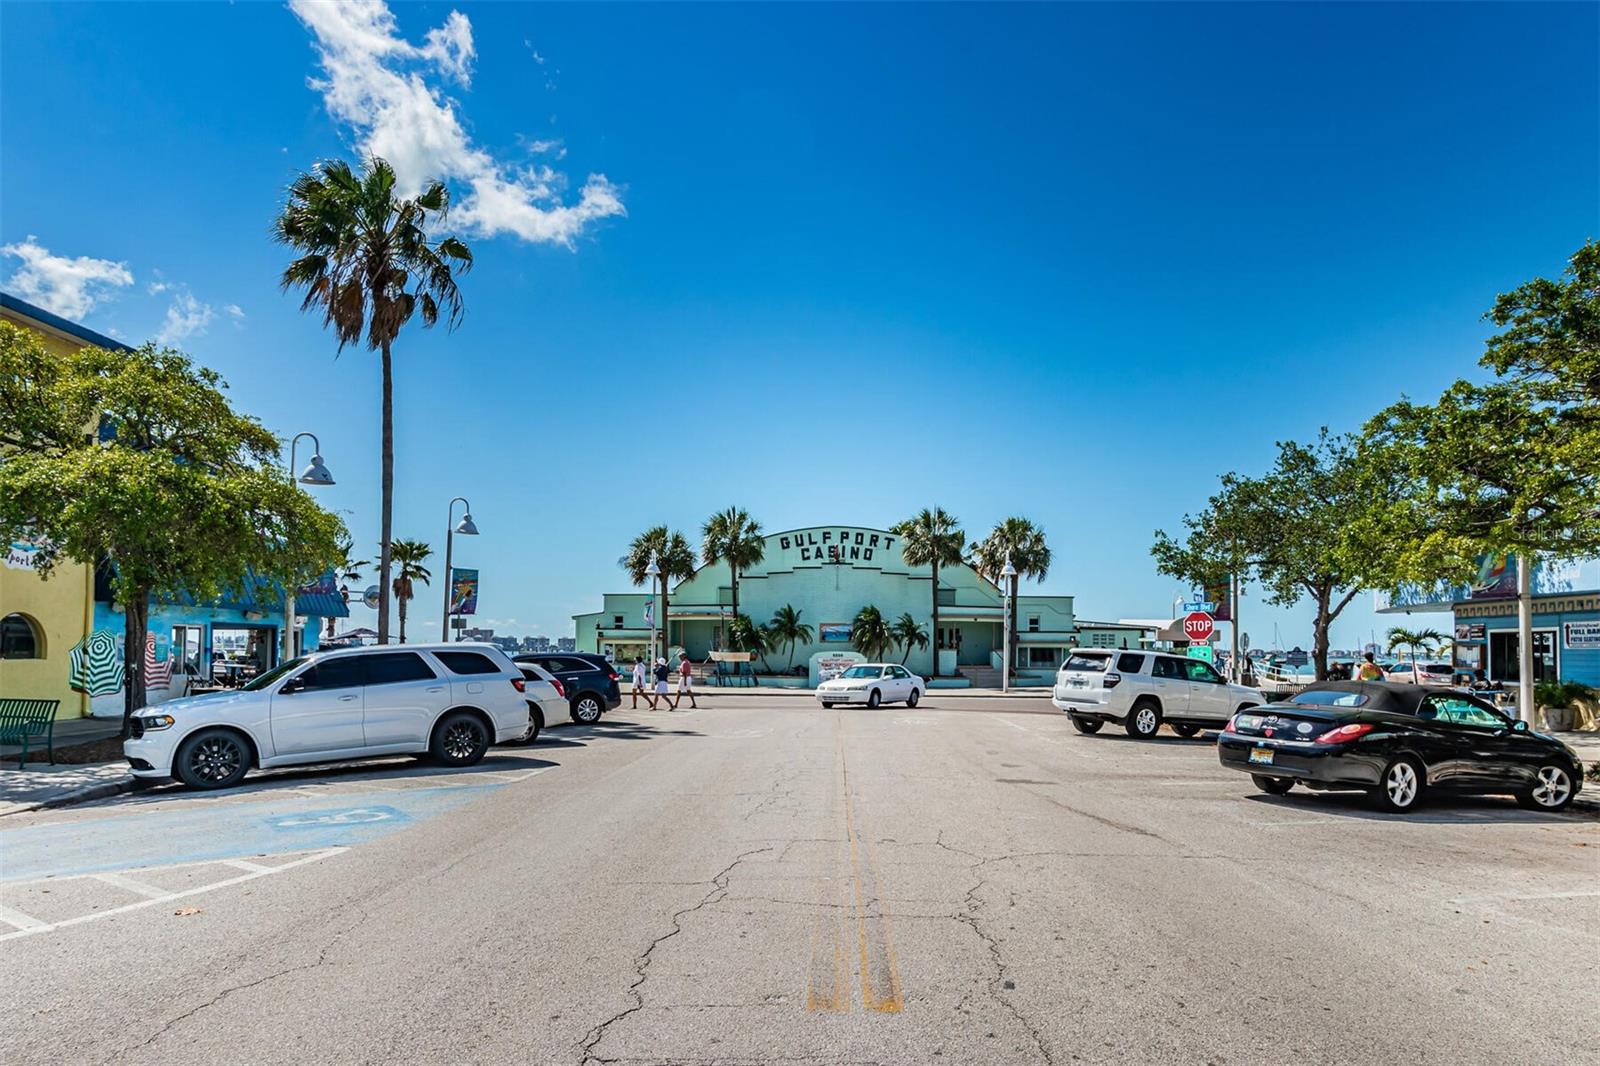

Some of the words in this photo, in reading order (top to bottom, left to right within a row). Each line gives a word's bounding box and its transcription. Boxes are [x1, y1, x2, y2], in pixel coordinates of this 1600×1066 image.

[780, 531, 896, 550] GULFPORT
[801, 545, 874, 561] CASINO
[1186, 620, 1212, 632] STOP
